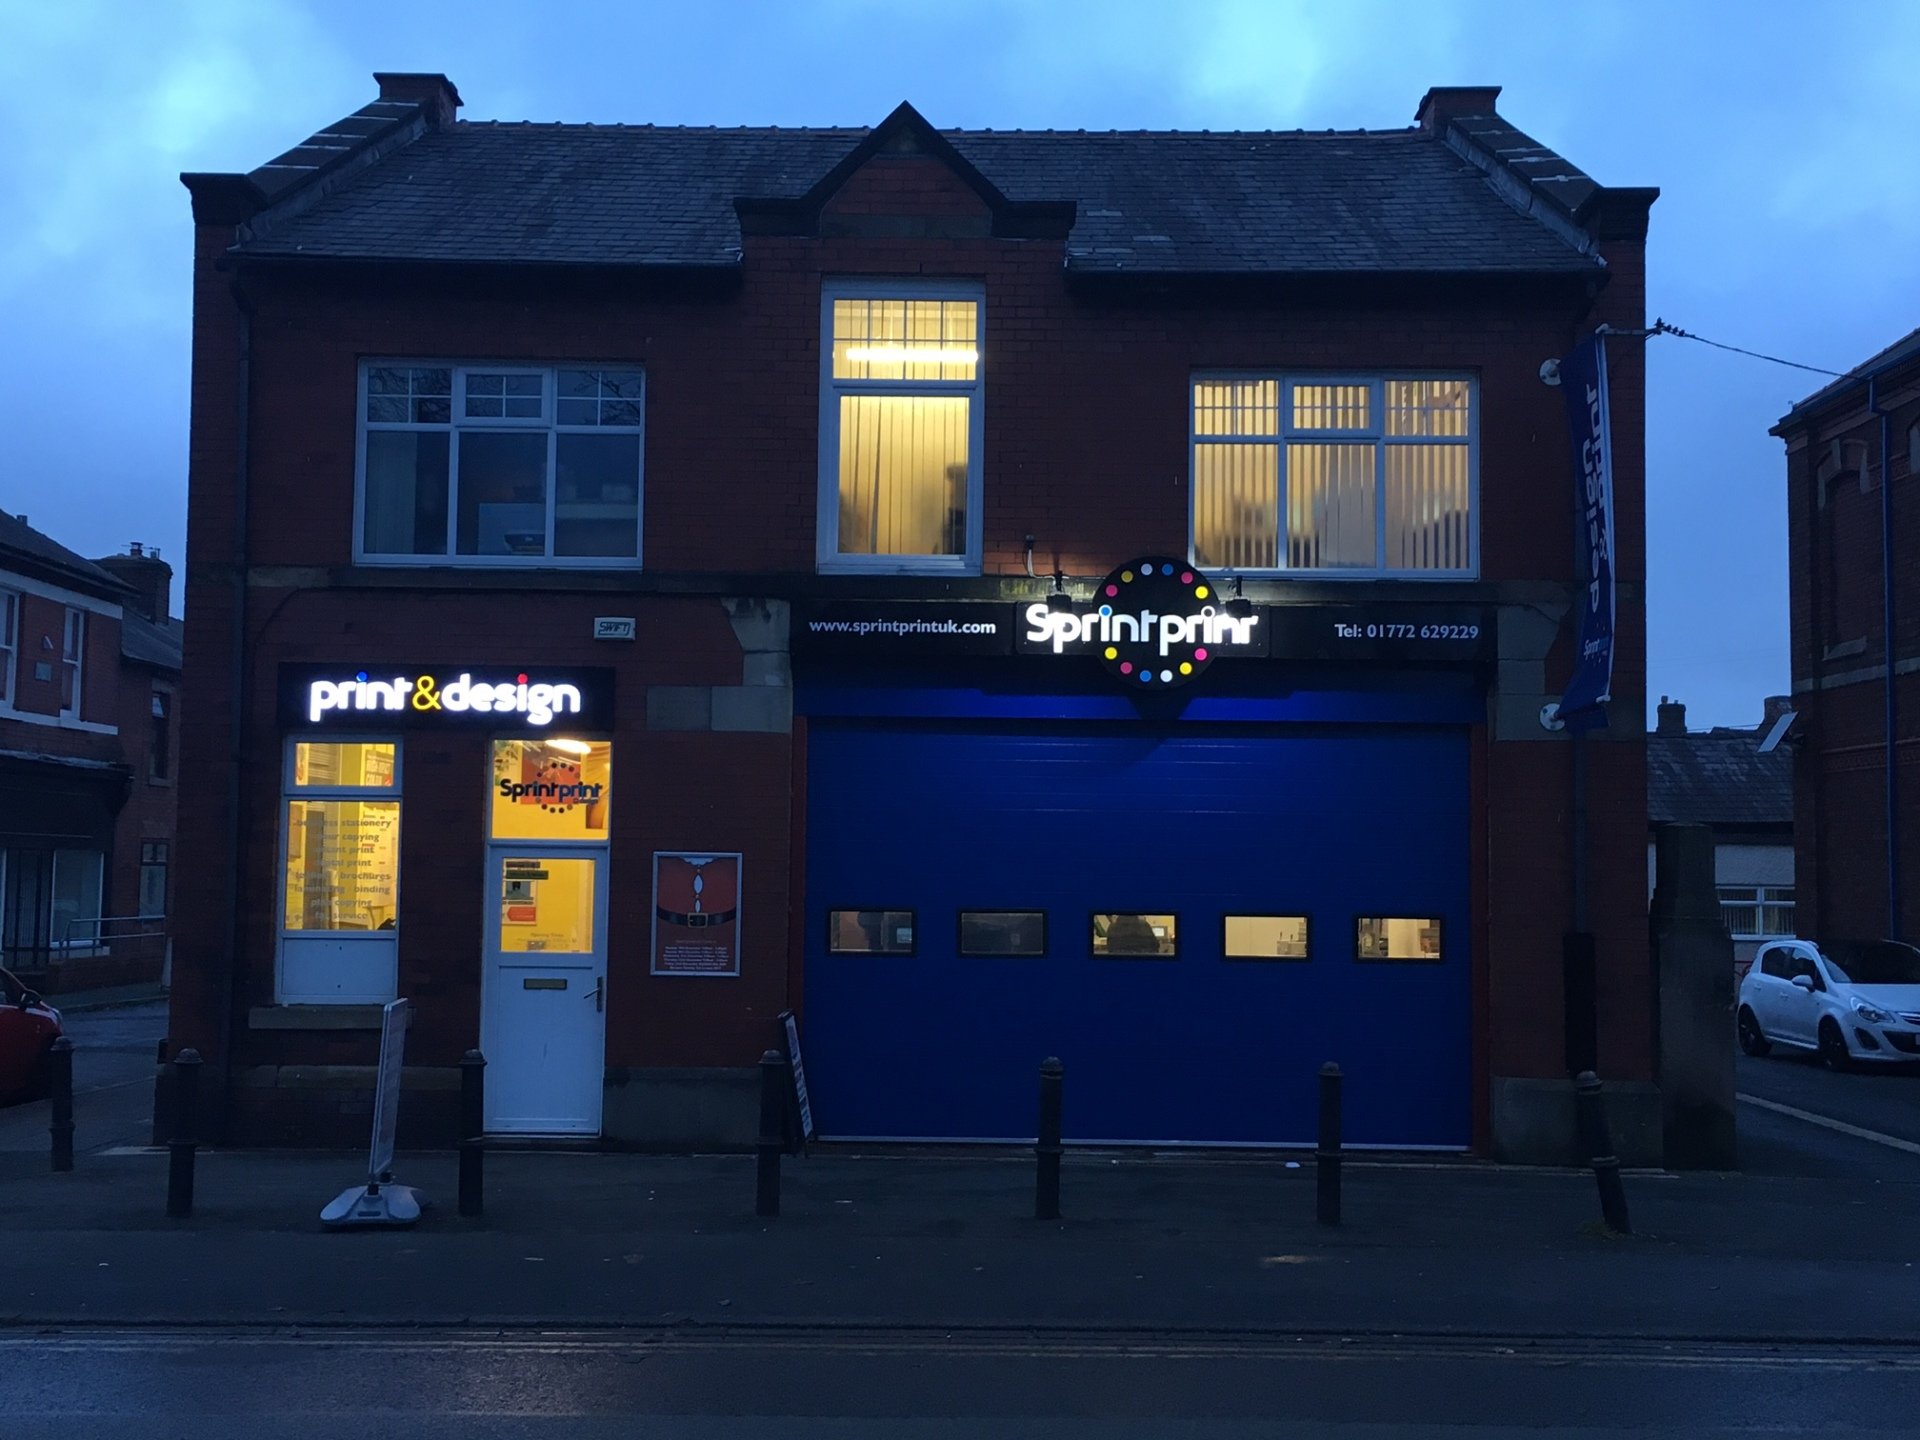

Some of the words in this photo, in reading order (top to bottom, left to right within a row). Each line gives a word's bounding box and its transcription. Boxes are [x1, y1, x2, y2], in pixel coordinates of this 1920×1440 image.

[1582, 439, 1600, 612] design
[809, 619, 996, 636] www.sprintprintuk.com
[1025, 603, 1259, 656] Sprintprint
[1334, 623, 1362, 638] Tel:
[1367, 624, 1416, 638] 01772
[1421, 625, 1479, 639] 629229
[500, 778, 603, 803] Sprintprint
[297, 818, 338, 827] buess
[341, 817, 392, 828] stationery
[342, 832, 380, 843] copying
[349, 845, 375, 855] print
[347, 859, 372, 868] print
[341, 871, 392, 881] brochures
[354, 885, 391, 895] binding
[335, 898, 373, 908] copying
[333, 911, 369, 919] service
